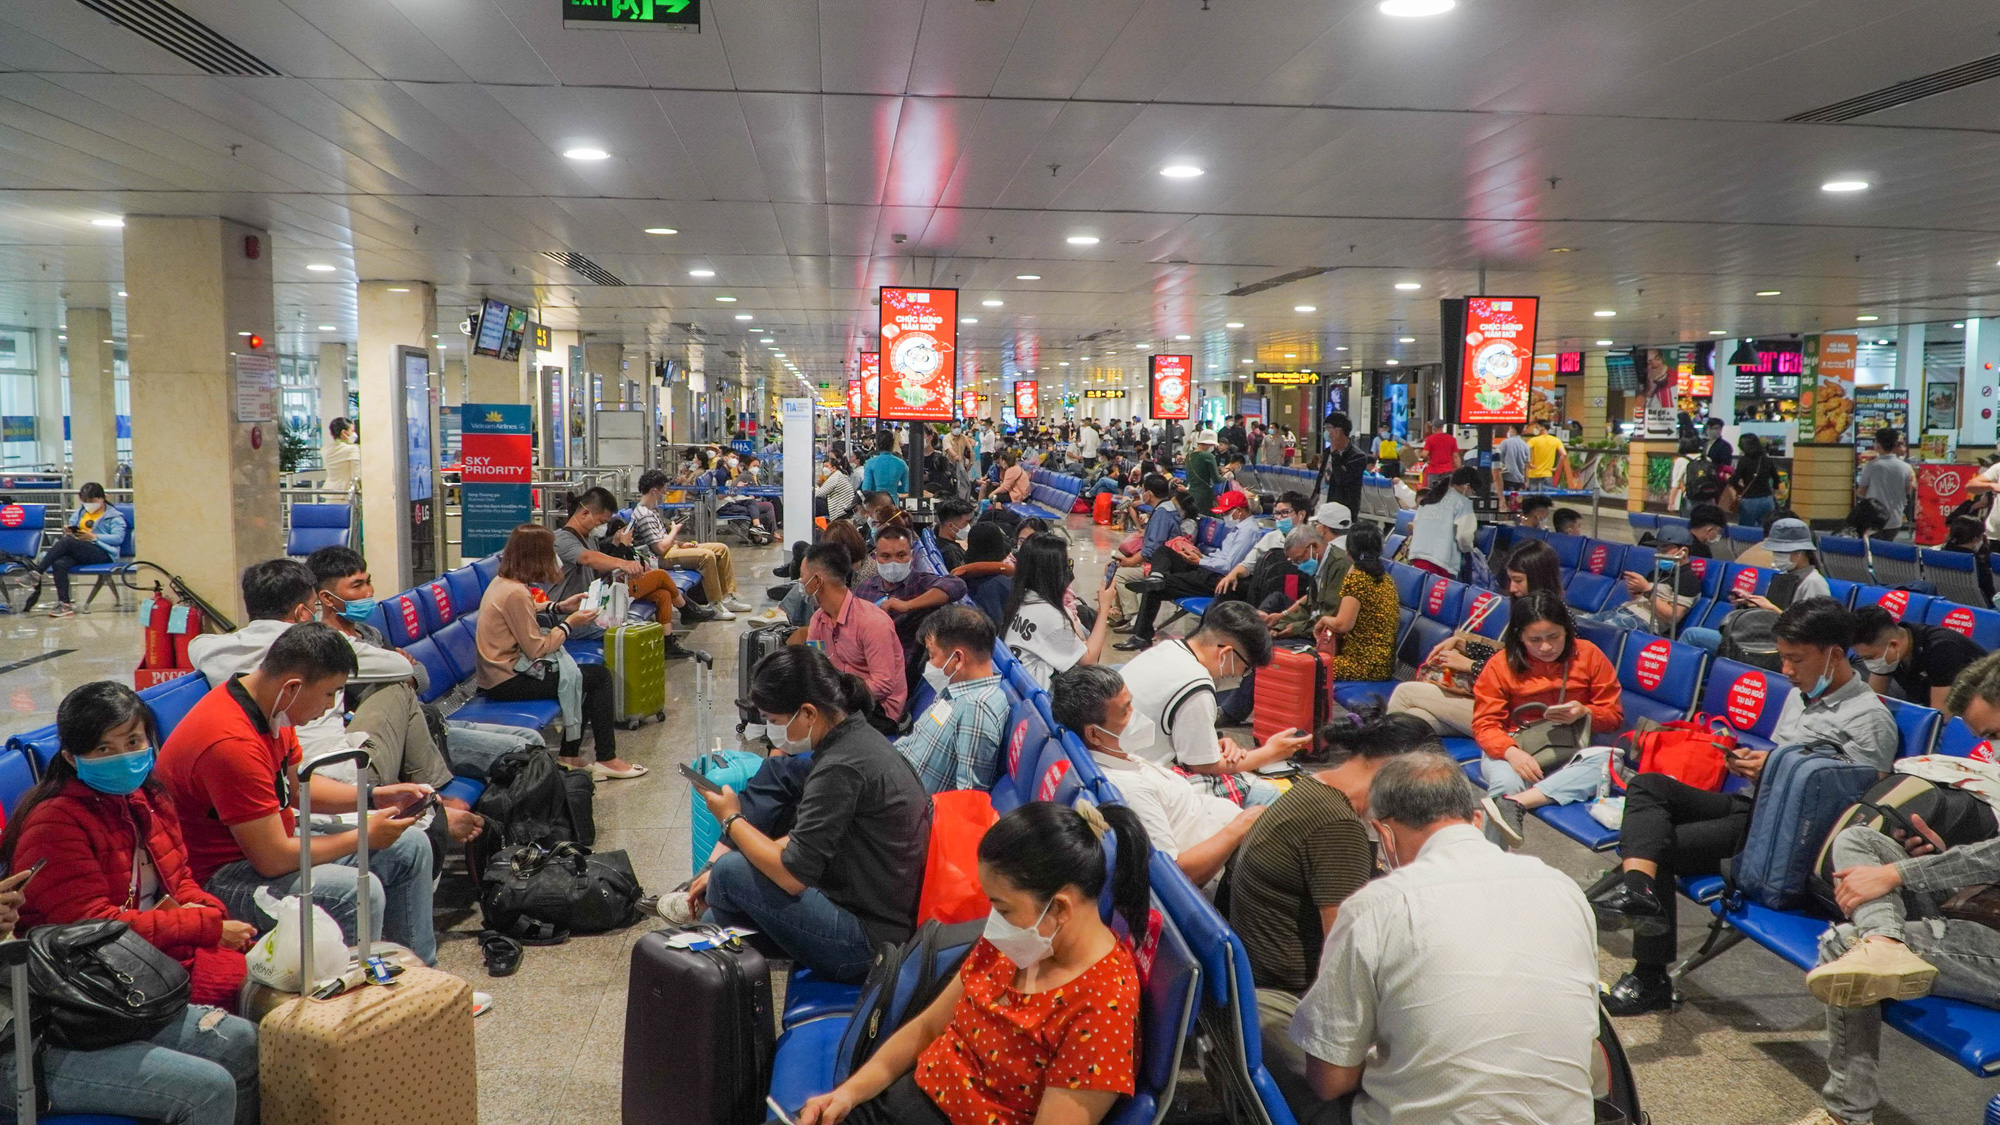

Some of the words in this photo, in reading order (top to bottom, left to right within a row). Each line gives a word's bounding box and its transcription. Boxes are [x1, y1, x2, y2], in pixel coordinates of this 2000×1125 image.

[895, 314, 918, 323] CHÚC
[465, 456, 491, 466] SKY
[465, 465, 524, 475] PRIORITY
[421, 504, 430, 521] LG
[1733, 684, 1751, 695] KHÔNG
